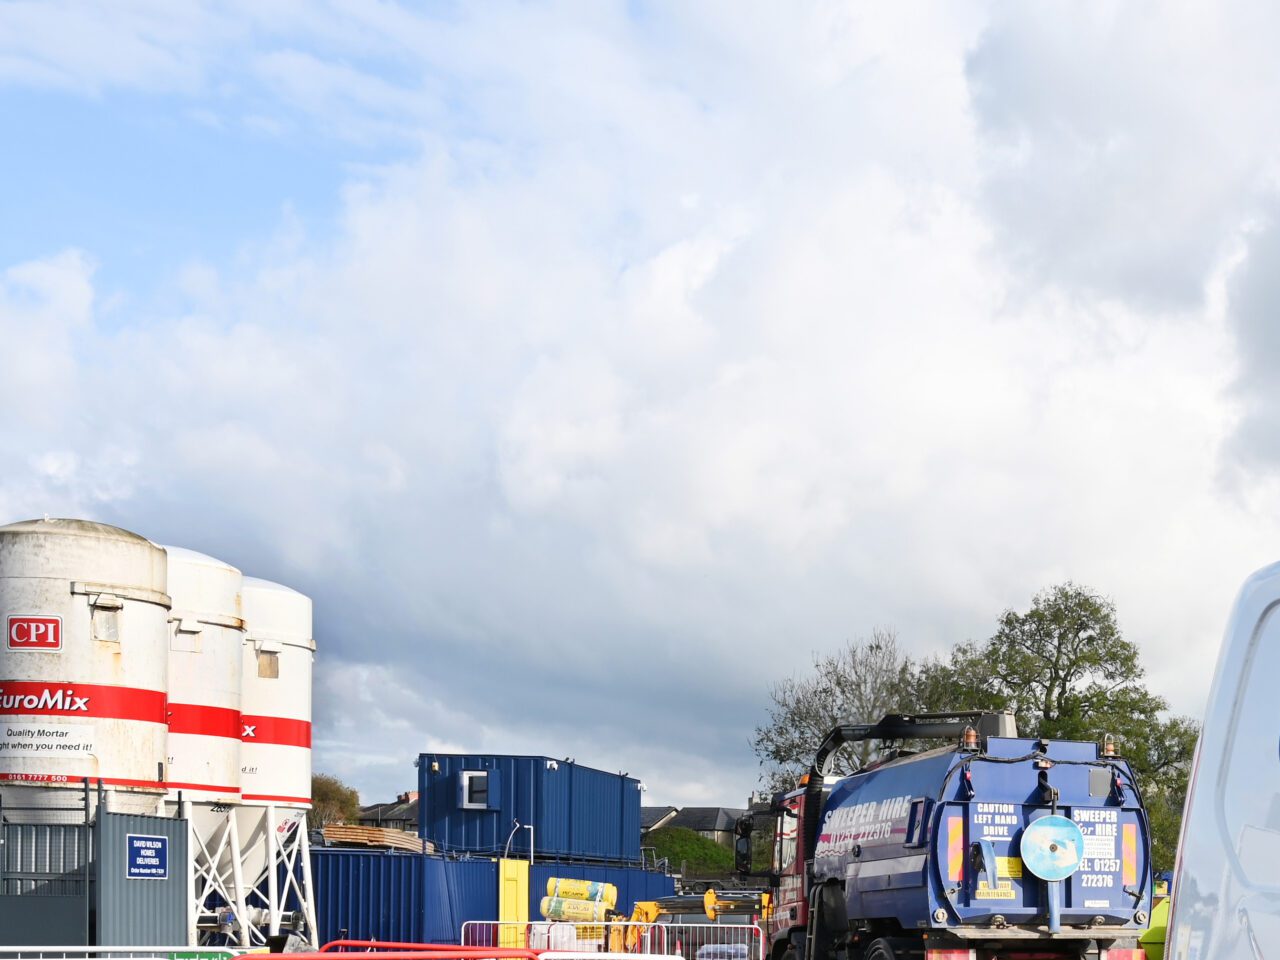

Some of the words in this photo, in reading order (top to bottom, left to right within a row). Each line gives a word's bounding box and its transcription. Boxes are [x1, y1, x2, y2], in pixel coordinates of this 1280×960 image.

[11, 622, 57, 643] CPI
[6, 728, 36, 739] Quality
[36, 729, 69, 738] Mortar
[11, 741, 33, 750] when
[35, 743, 53, 753] you
[55, 743, 80, 751] need
[824, 801, 877, 828] SWEEPER
[879, 794, 912, 821] HIRE
[977, 803, 1014, 813] CAUTION
[974, 814, 992, 824] LEFT
[994, 814, 1018, 824] HAND
[1073, 809, 1118, 822] SWEEPER
[858, 821, 892, 841] 272376
[983, 825, 1008, 835] DRIVE
[1095, 823, 1118, 836] HIRE
[1094, 859, 1120, 872] 01257
[1081, 874, 1113, 887] 272376
